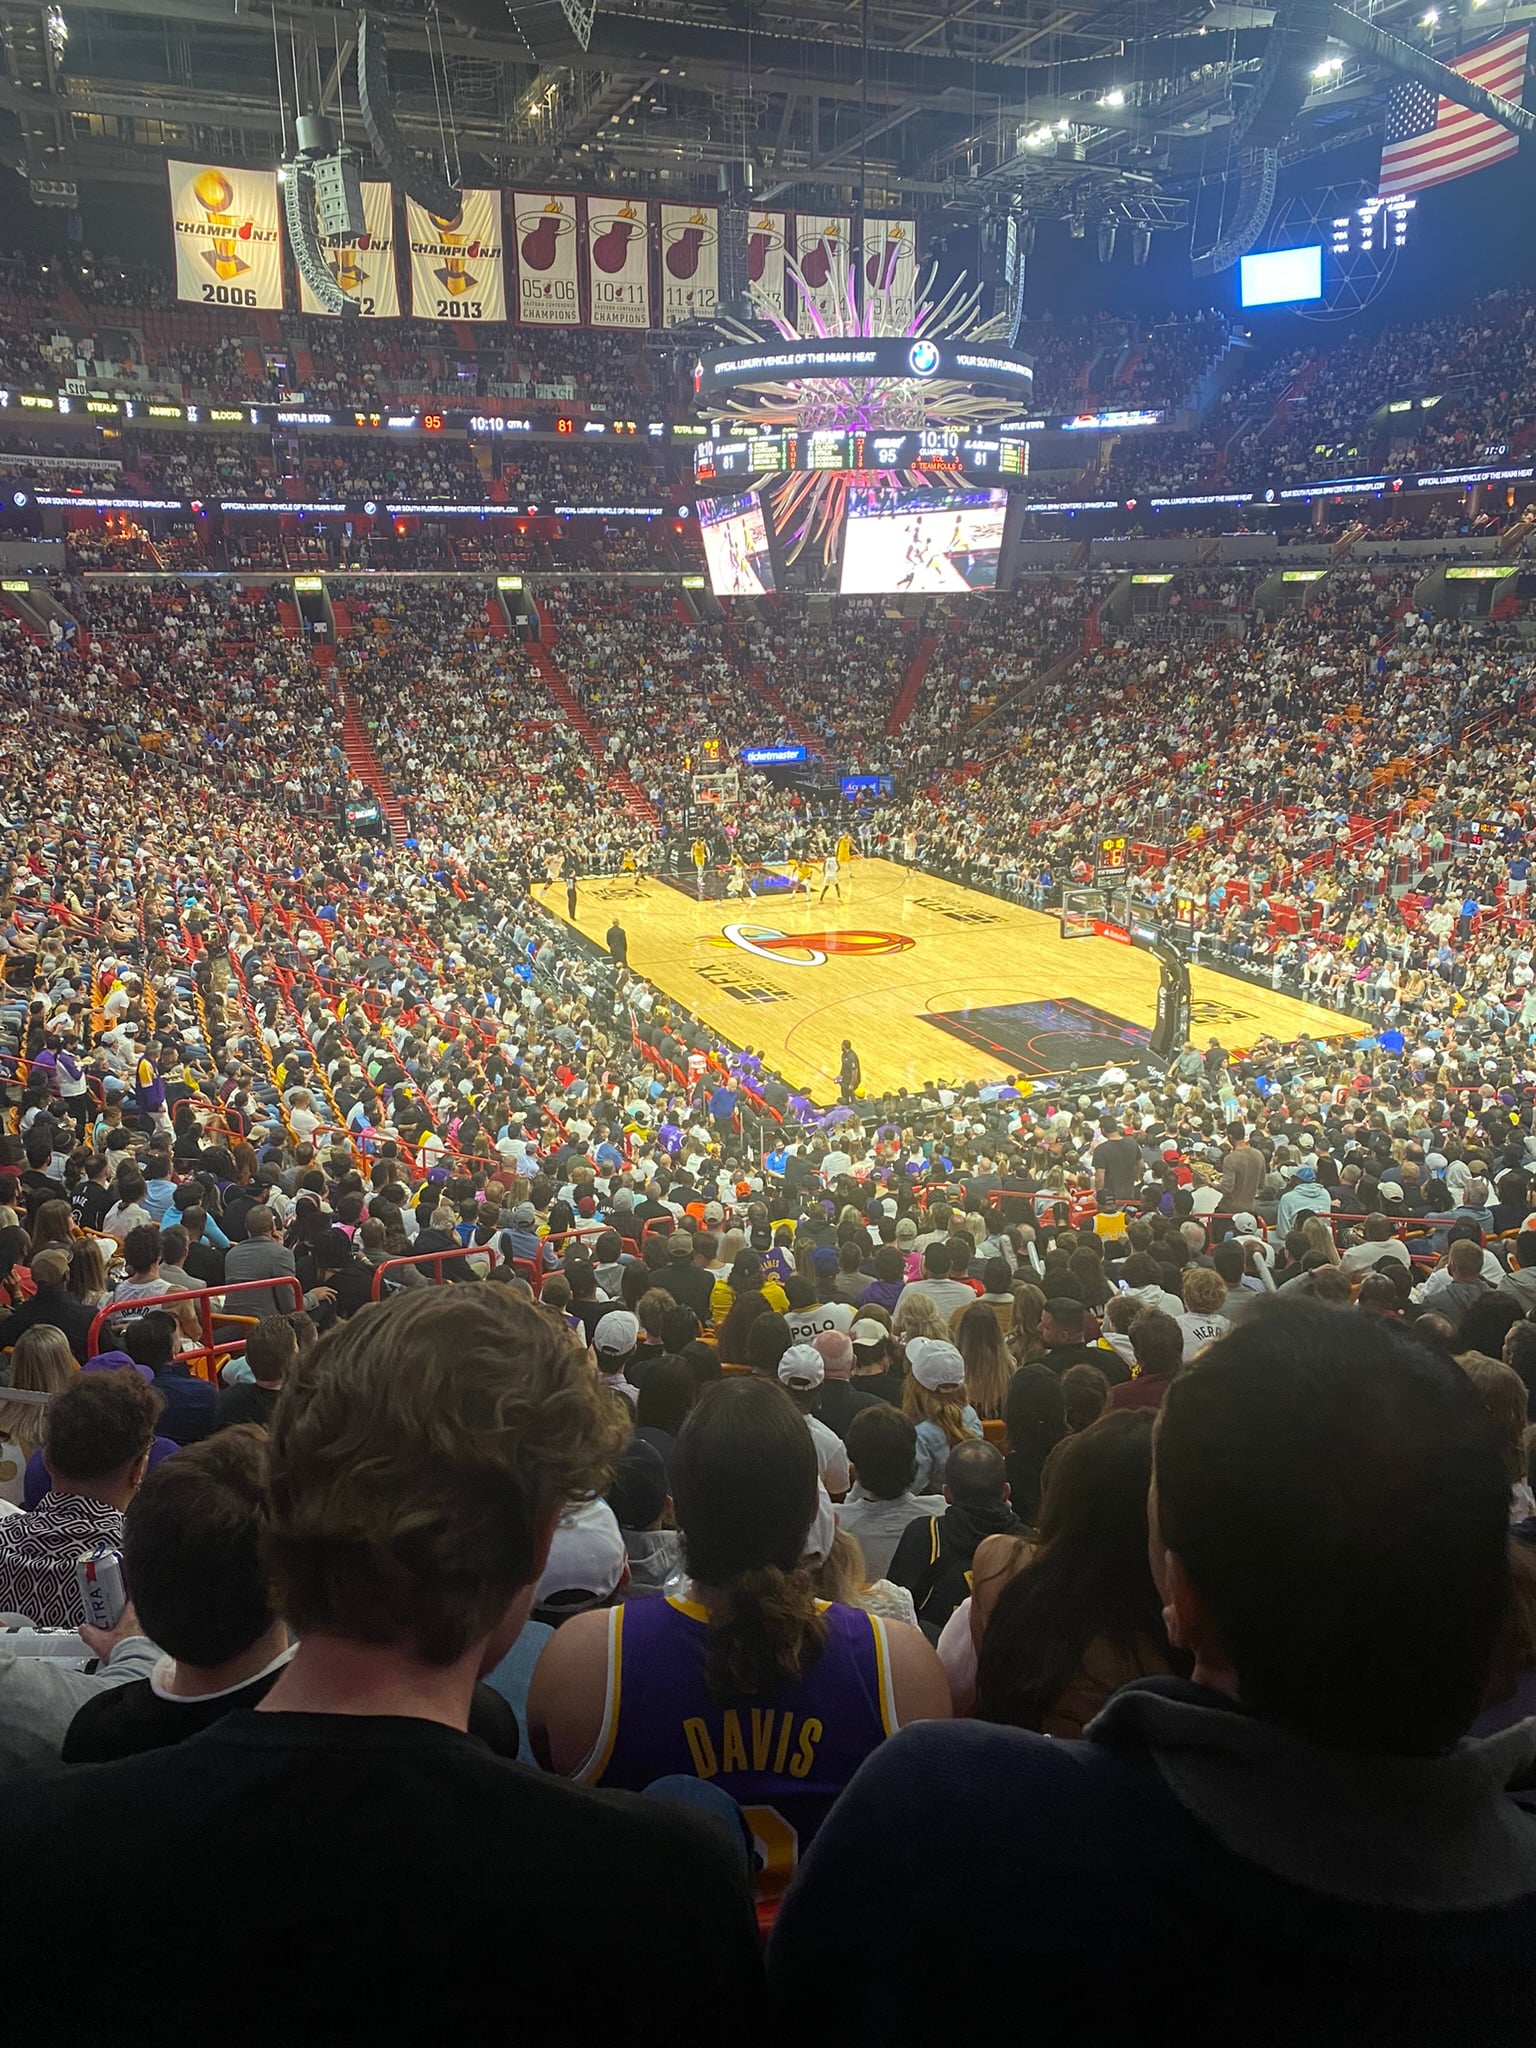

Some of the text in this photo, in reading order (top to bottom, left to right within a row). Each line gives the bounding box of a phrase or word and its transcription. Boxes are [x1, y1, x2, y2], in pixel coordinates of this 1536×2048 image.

[202, 284, 257, 307] 2006
[522, 279, 575, 300] 05 06
[595, 282, 644, 304] 10 11
[666, 286, 715, 308] 11 12
[437, 300, 482, 319] 2013
[523, 309, 577, 320] CHAMPIONS
[594, 312, 647, 324] CHAMPIONS
[715, 352, 877, 374] OFFICIAL LUXURY VEHICLE OF THE MIAMI HEAT
[957, 355, 976, 366] YOUR
[977, 357, 997, 369] SOUTH
[87, 402, 118, 412] STEALS
[149, 407, 181, 417] ASSISTS
[211, 410, 243, 420] BLOCKS
[278, 413, 331, 424] HUSTLE STATS
[423, 415, 441, 428] 95
[470, 417, 504, 431] 10:10
[507, 420, 530, 430] QTR 4
[558, 419, 573, 432] 81
[673, 425, 692, 435] TOTAL
[919, 431, 959, 449] 10:10
[879, 448, 897, 464] 95
[919, 448, 949, 456] QUARTER
[974, 451, 988, 466] 81
[1418, 478, 1440, 486] OFFICIAL
[1482, 473, 1490, 481] OF
[1490, 472, 1502, 480] THE
[1518, 469, 1534, 478] HEAT
[36, 496, 51, 504] YOUR
[52, 497, 71, 505] SOUTH
[71, 498, 96, 506] FLORIDA
[386, 504, 402, 512] YOUR
[747, 749, 800, 762] ticketmaster
[1112, 849, 1122, 867] 6
[689, 964, 741, 985] FTX
[72, 1195, 88, 1207] WADE
[791, 1319, 835, 1340] POLO
[682, 1708, 824, 1779] DAVIS
